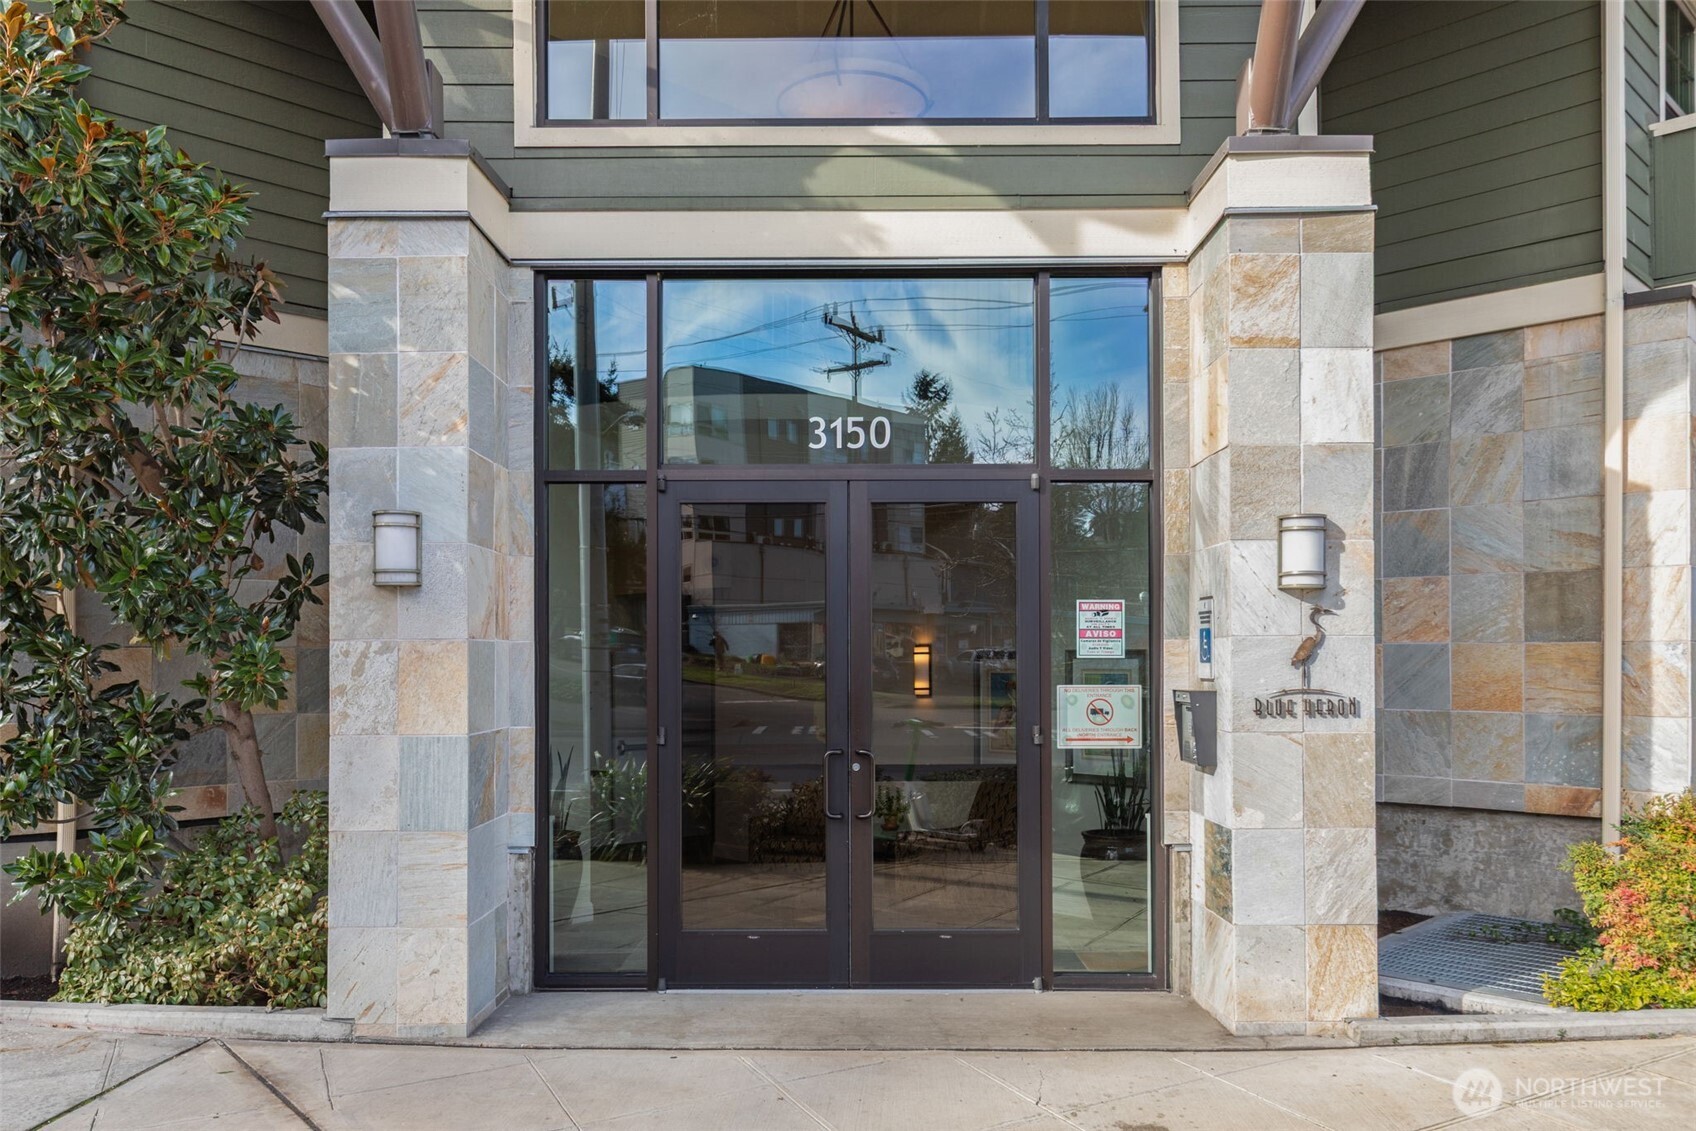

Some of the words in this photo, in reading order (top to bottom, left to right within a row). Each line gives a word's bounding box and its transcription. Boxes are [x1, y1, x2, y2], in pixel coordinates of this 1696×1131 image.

[808, 416, 891, 449] 3150
[1253, 698, 1296, 717] BLUE
[1303, 697, 1357, 717] HERON
